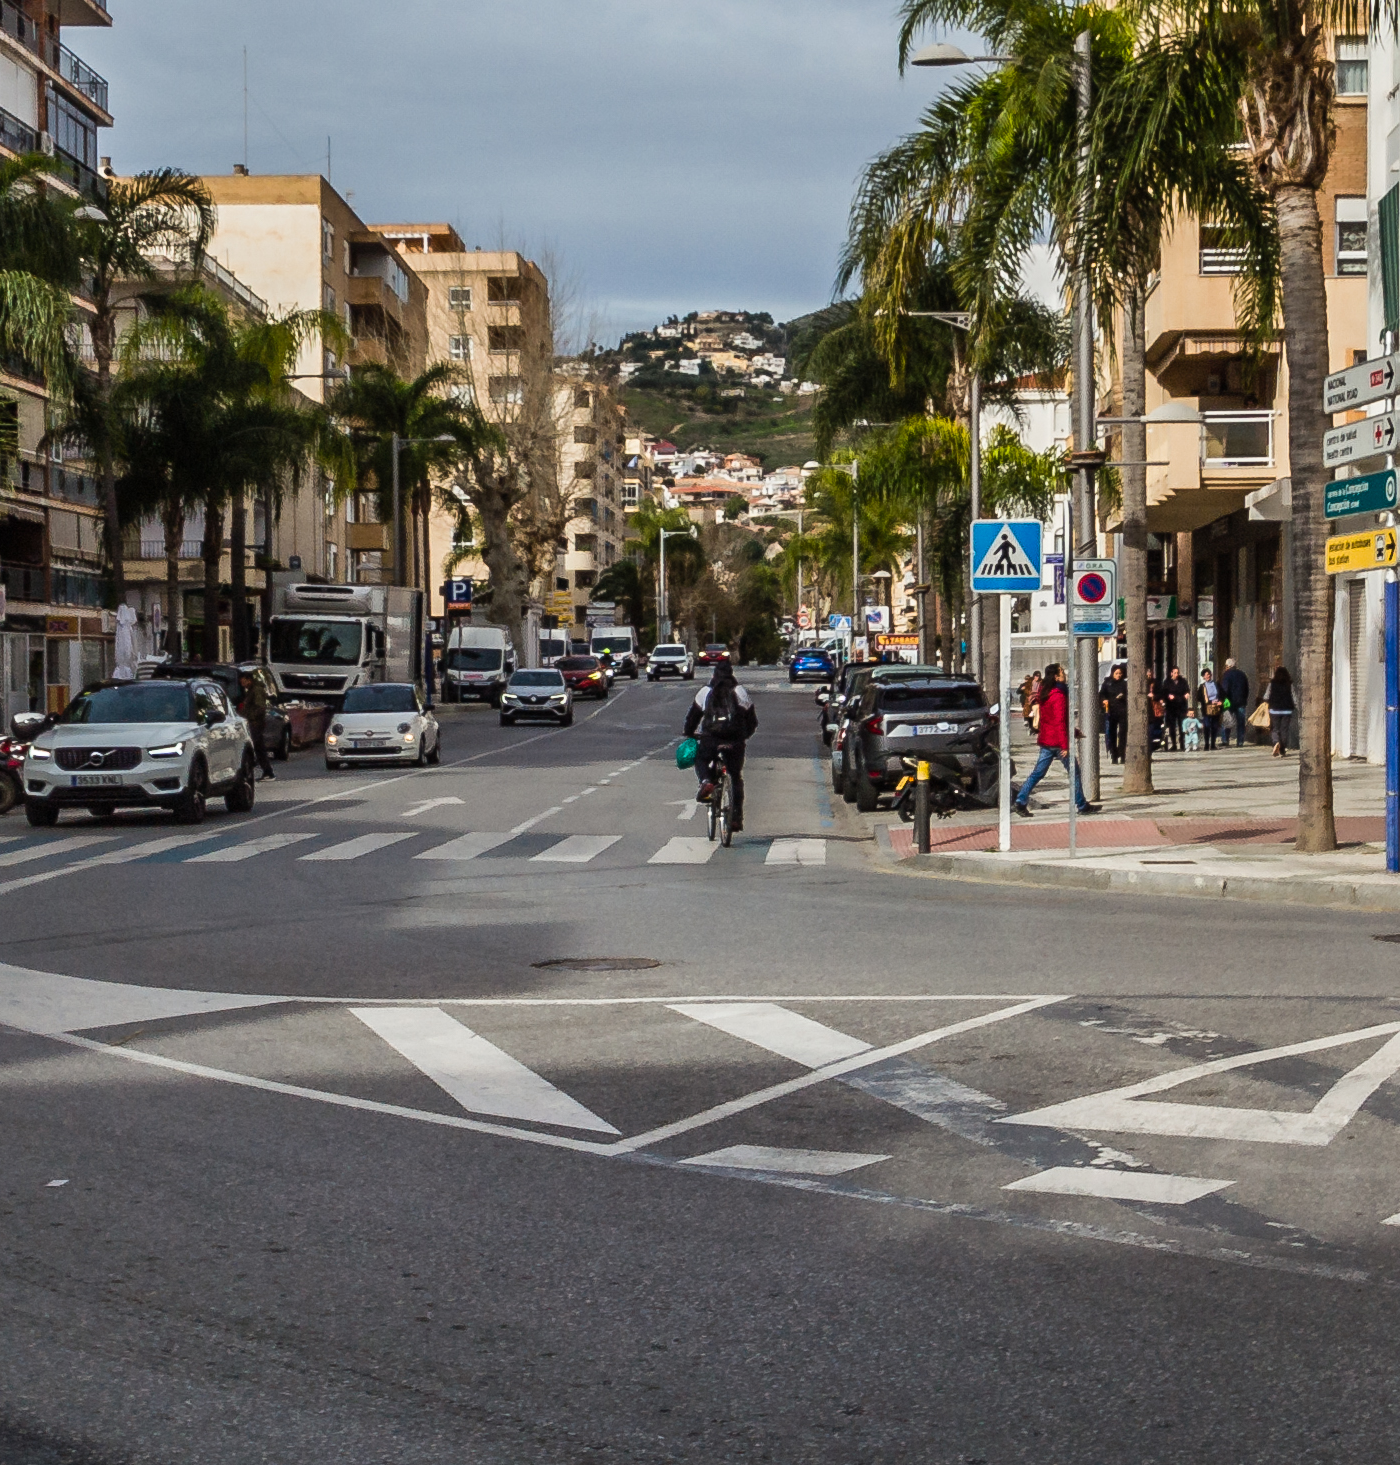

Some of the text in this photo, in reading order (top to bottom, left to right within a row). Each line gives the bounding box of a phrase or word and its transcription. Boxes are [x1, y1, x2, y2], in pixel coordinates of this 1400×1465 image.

[1327, 387, 1358, 406] NATIONAL ROAD
[452, 582, 467, 601] P
[918, 725, 939, 734] 3772
[77, 775, 119, 785] 3533 KNL
